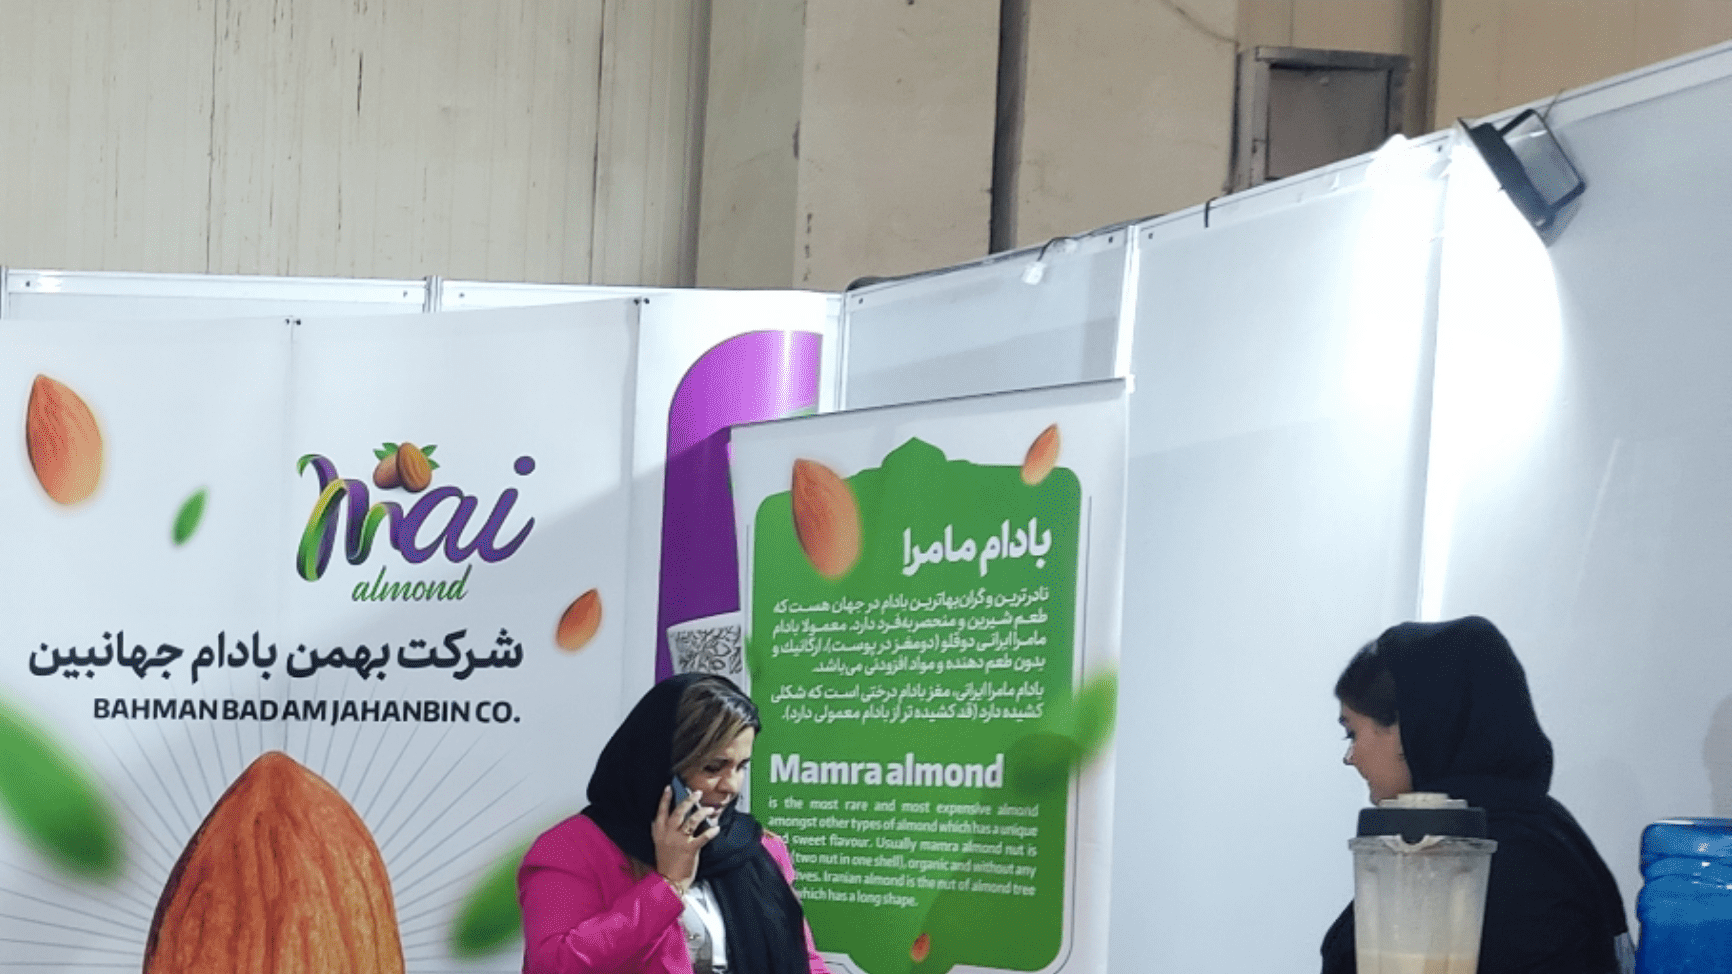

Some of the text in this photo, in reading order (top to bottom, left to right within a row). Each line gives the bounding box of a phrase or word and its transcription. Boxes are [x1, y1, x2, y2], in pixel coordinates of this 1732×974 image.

[902, 517, 1052, 577] بادام مامرا
[351, 564, 472, 602] almond
[773, 599, 789, 613] که
[789, 601, 831, 613] هست
[831, 596, 865, 613] جهان
[866, 598, 881, 613] در
[881, 593, 909, 614] بادام
[968, 610, 1013, 630] شیرین
[1014, 608, 1048, 627] طعم
[772, 618, 800, 639] بادام
[1013, 630, 1047, 650] مامرا
[28, 628, 525, 684] شرکت بهمن بادام جهانبین
[909, 655, 935, 674] مواد
[985, 653, 1012, 674] طعم
[1013, 655, 1046, 672] بدون
[771, 684, 806, 704] شکلی
[807, 684, 824, 699] که
[824, 683, 860, 700] است
[861, 684, 898, 704] درختی
[898, 682, 926, 704] بادام
[926, 683, 950, 702] مغز
[989, 681, 1015, 701] مامرا
[1015, 681, 1045, 702] بادام
[93, 697, 522, 726] BAHMAN BADAM JAHANBIN CO.
[814, 705, 860, 724] معمولی
[862, 704, 890, 725] بادام
[915, 703, 957, 722] کشیده
[979, 704, 1002, 724] دارد
[1003, 702, 1045, 722] کشیده
[770, 752, 1004, 788] Mamra almond
[768, 797, 1039, 818] is the most rare and most expensive almond
[768, 817, 817, 831] amongst
[819, 816, 849, 829] other
[851, 818, 882, 833] types
[883, 817, 895, 830] of
[896, 818, 938, 833] almond
[939, 819, 971, 834] which
[972, 821, 992, 835] has
[1000, 823, 1039, 839] unique
[793, 834, 827, 847] sweet
[876, 836, 917, 852] Usually
[920, 839, 959, 852] mamra
[961, 839, 1003, 855] almond
[1005, 844, 1025, 857] nut
[1027, 843, 1038, 858] is
[819, 852, 838, 865] nut
[839, 852, 850, 865] in
[851, 854, 872, 867] one
[908, 857, 950, 873] organic
[950, 858, 972, 873] and
[973, 860, 1014, 875] without
[1015, 863, 1037, 880] any
[824, 870, 862, 884] Iranian
[864, 872, 906, 887] almond
[907, 874, 916, 887] is
[917, 875, 935, 889] the
[936, 877, 956, 890] nut
[958, 877, 970, 891] of
[971, 879, 1013, 895] almond
[828, 888, 848, 902] has
[857, 889, 882, 906] long
